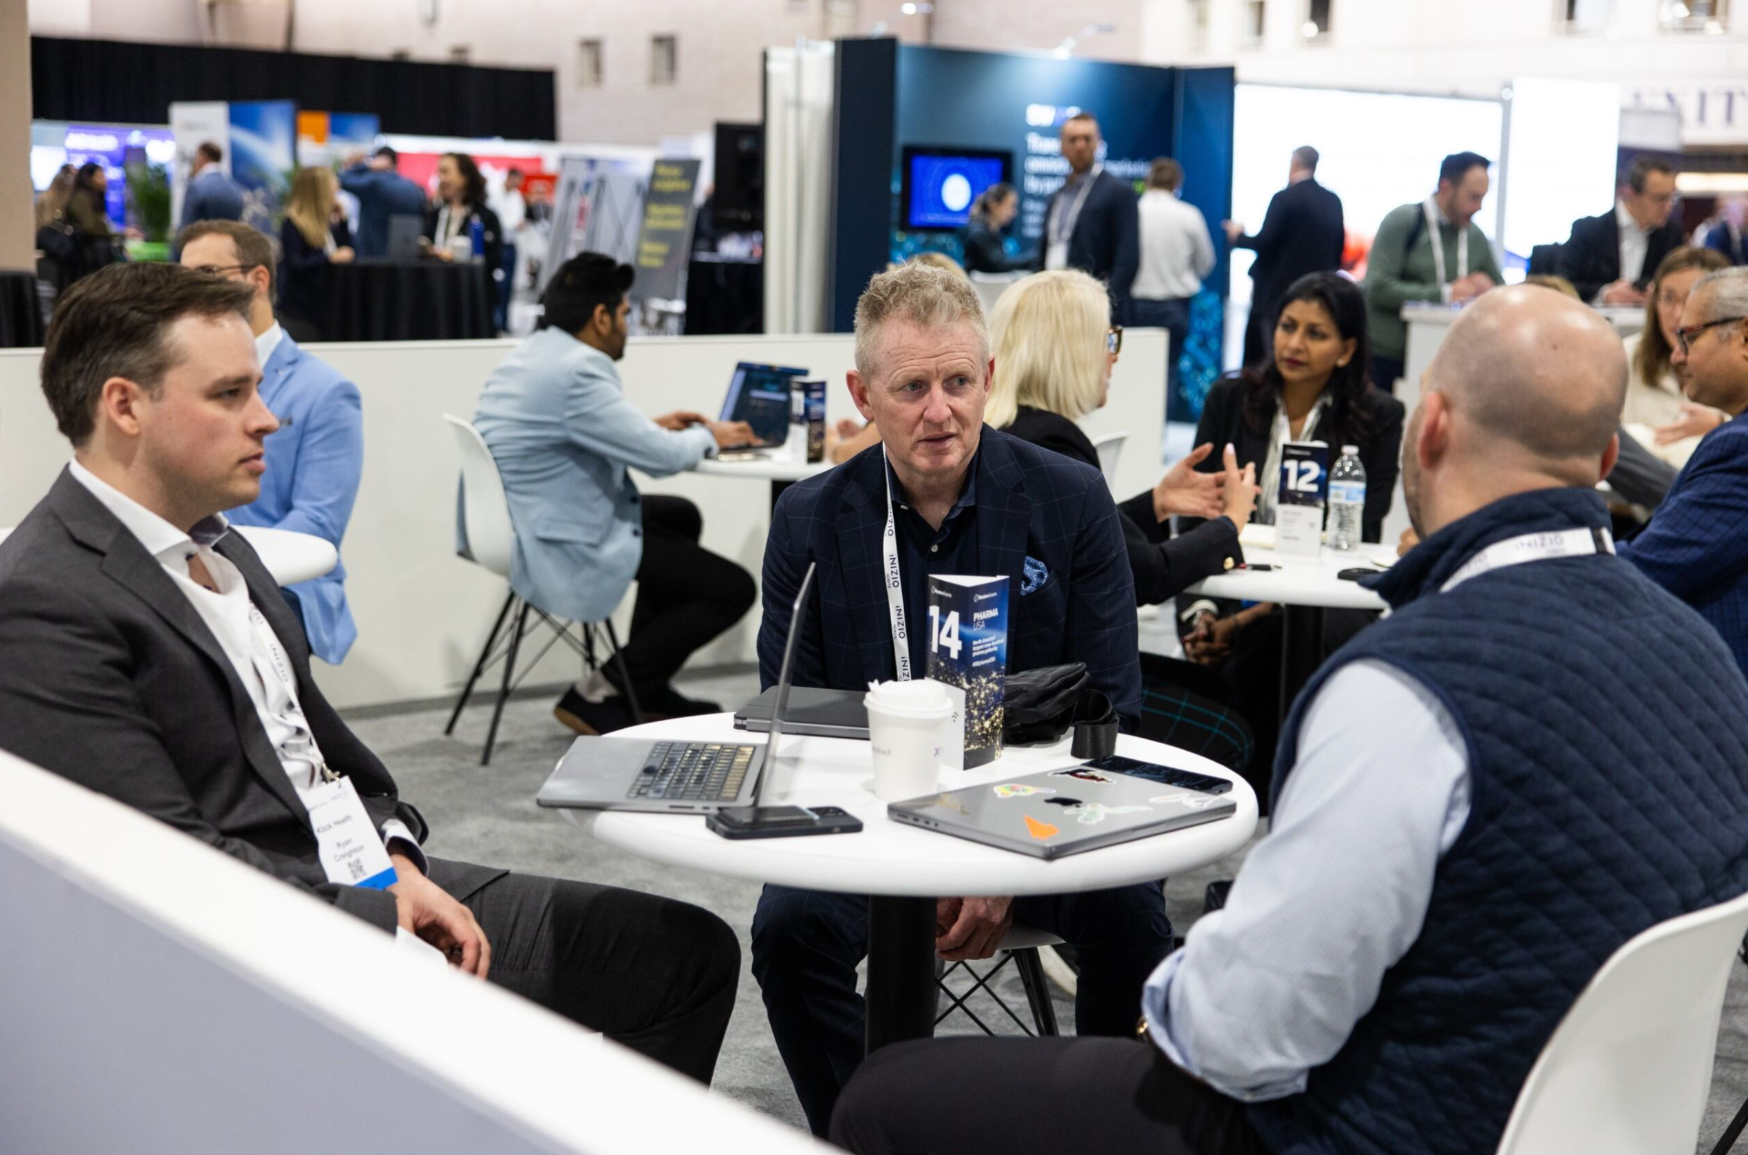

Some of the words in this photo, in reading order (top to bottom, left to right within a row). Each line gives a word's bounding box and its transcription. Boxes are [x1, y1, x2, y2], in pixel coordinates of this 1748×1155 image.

[1283, 459, 1320, 492] 12
[973, 607, 998, 621] PHARMA
[973, 620, 985, 631] USA
[929, 605, 962, 660] 14
